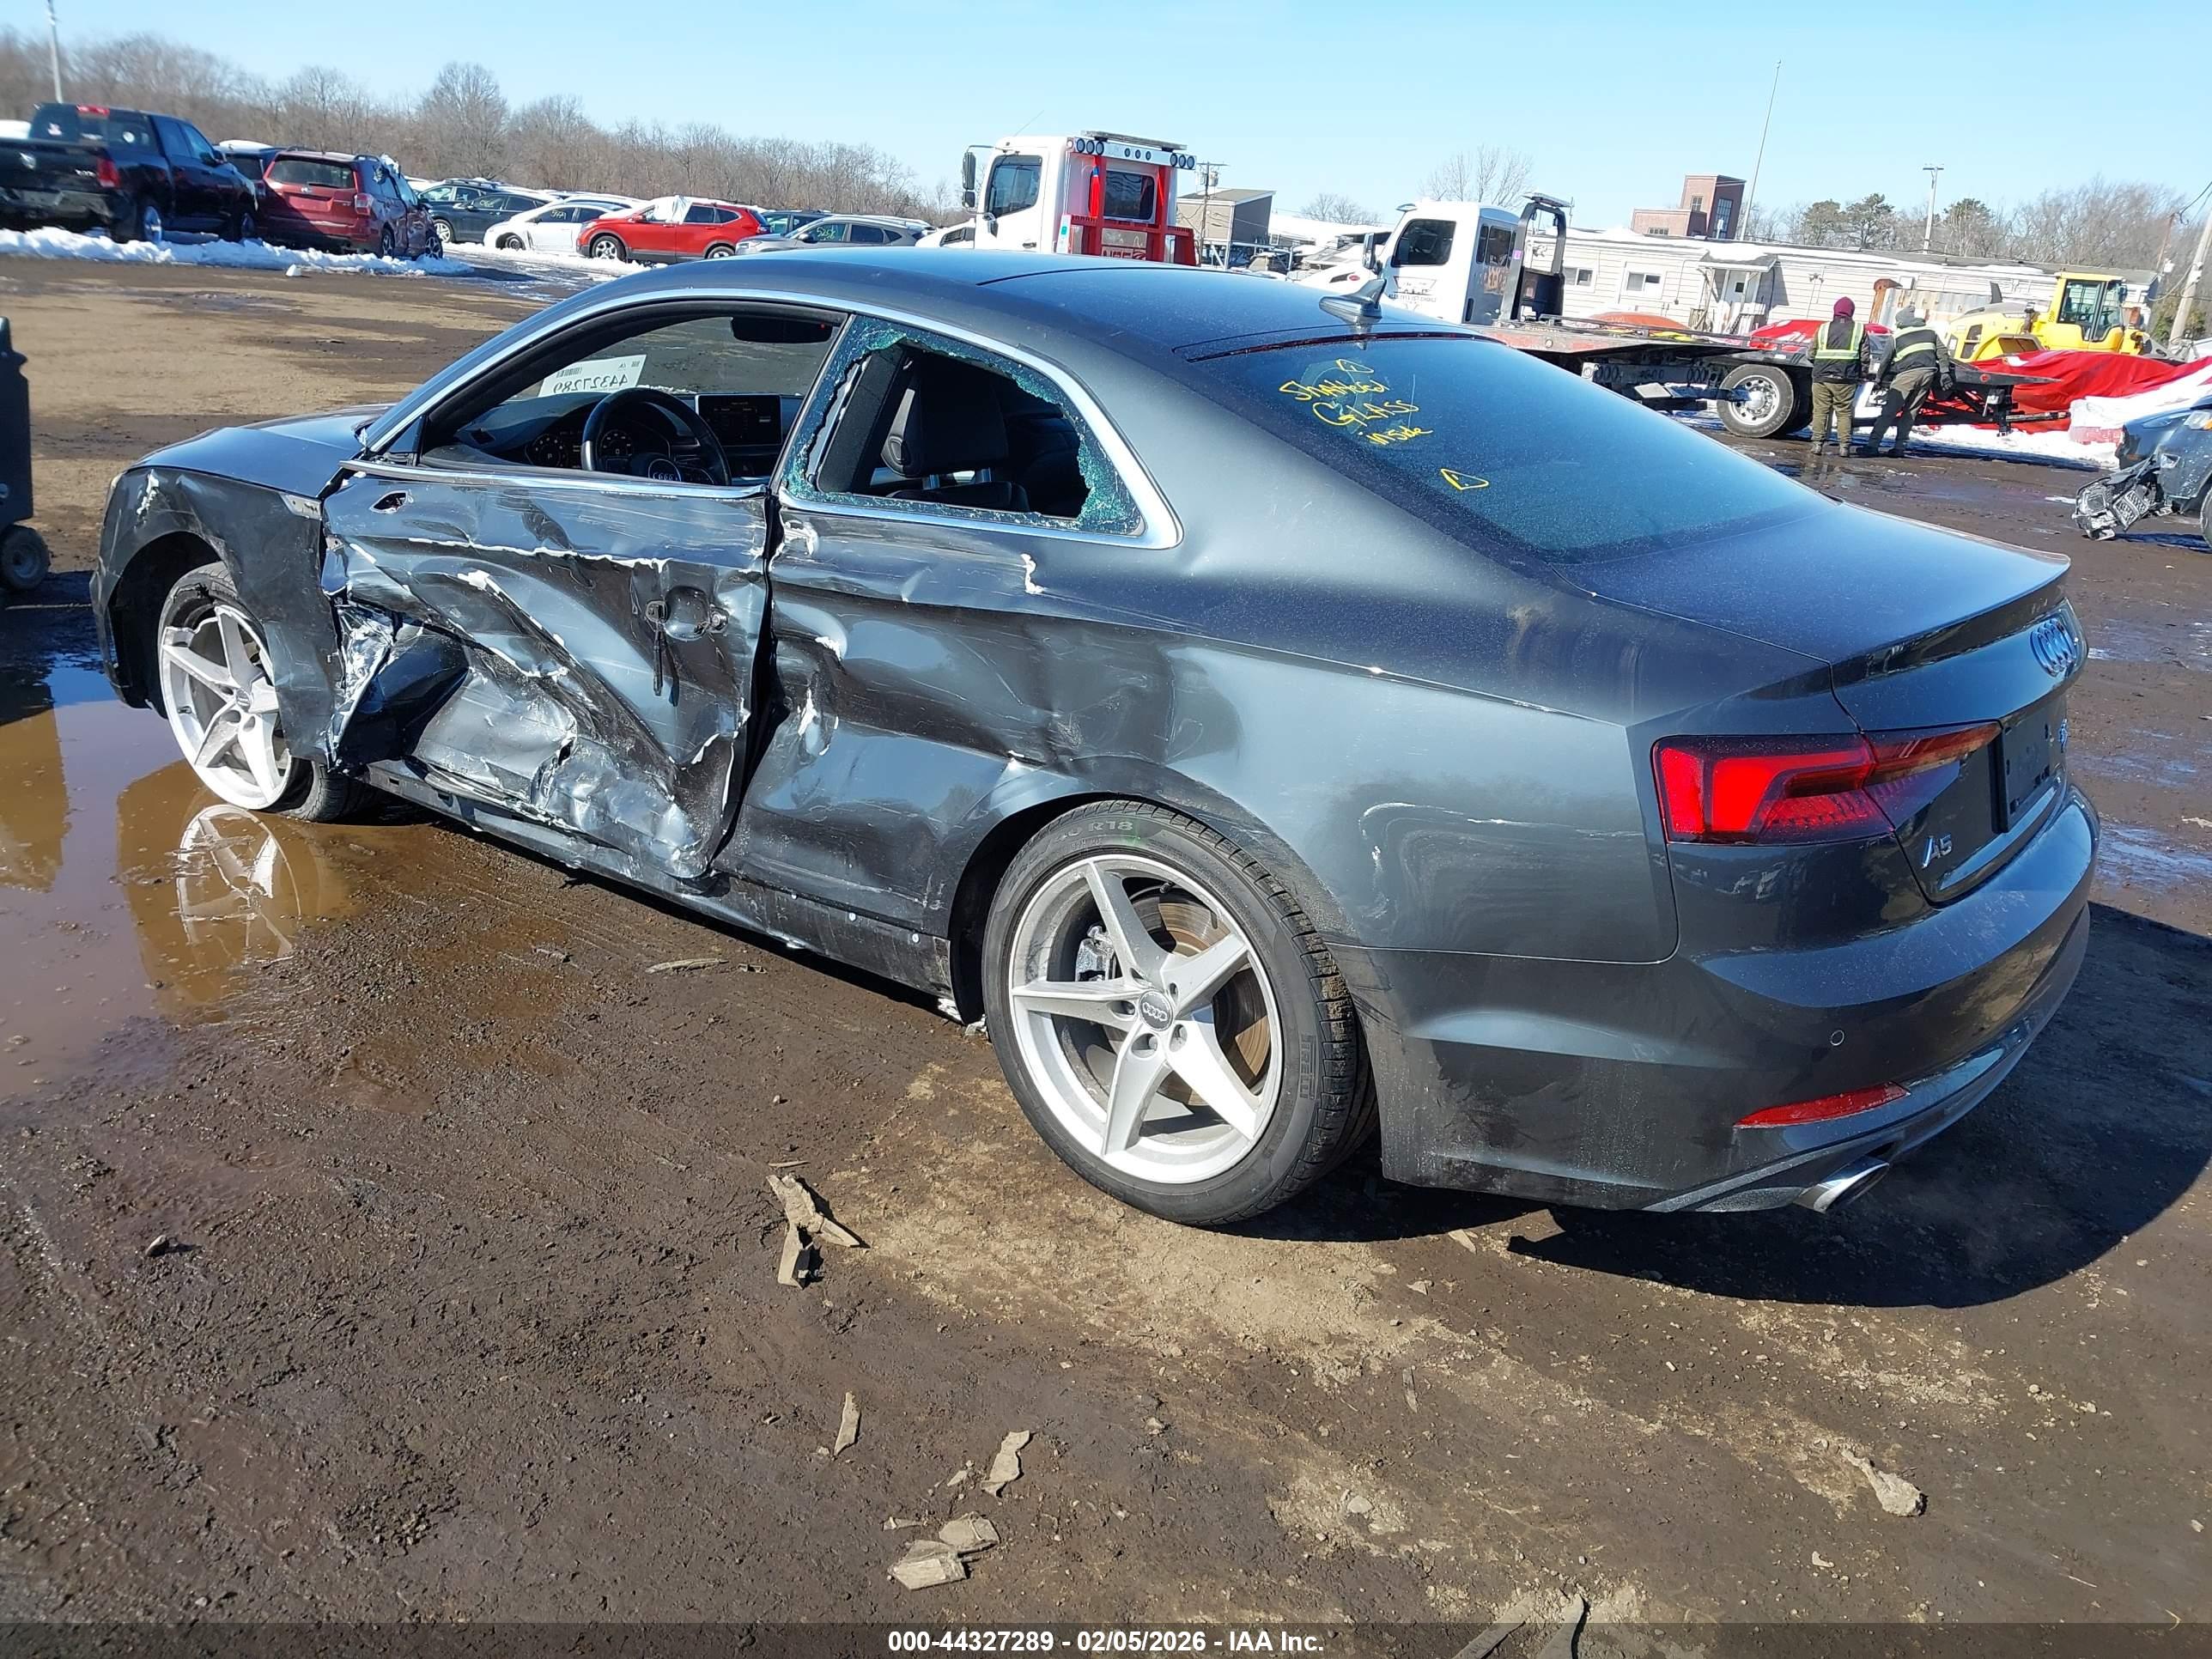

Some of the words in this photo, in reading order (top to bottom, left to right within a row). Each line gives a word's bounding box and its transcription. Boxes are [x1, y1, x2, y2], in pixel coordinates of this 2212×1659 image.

[1312, 399, 1419, 427] GLASS
[1088, 820, 1133, 832] R18
[1922, 834, 1952, 868] A5
